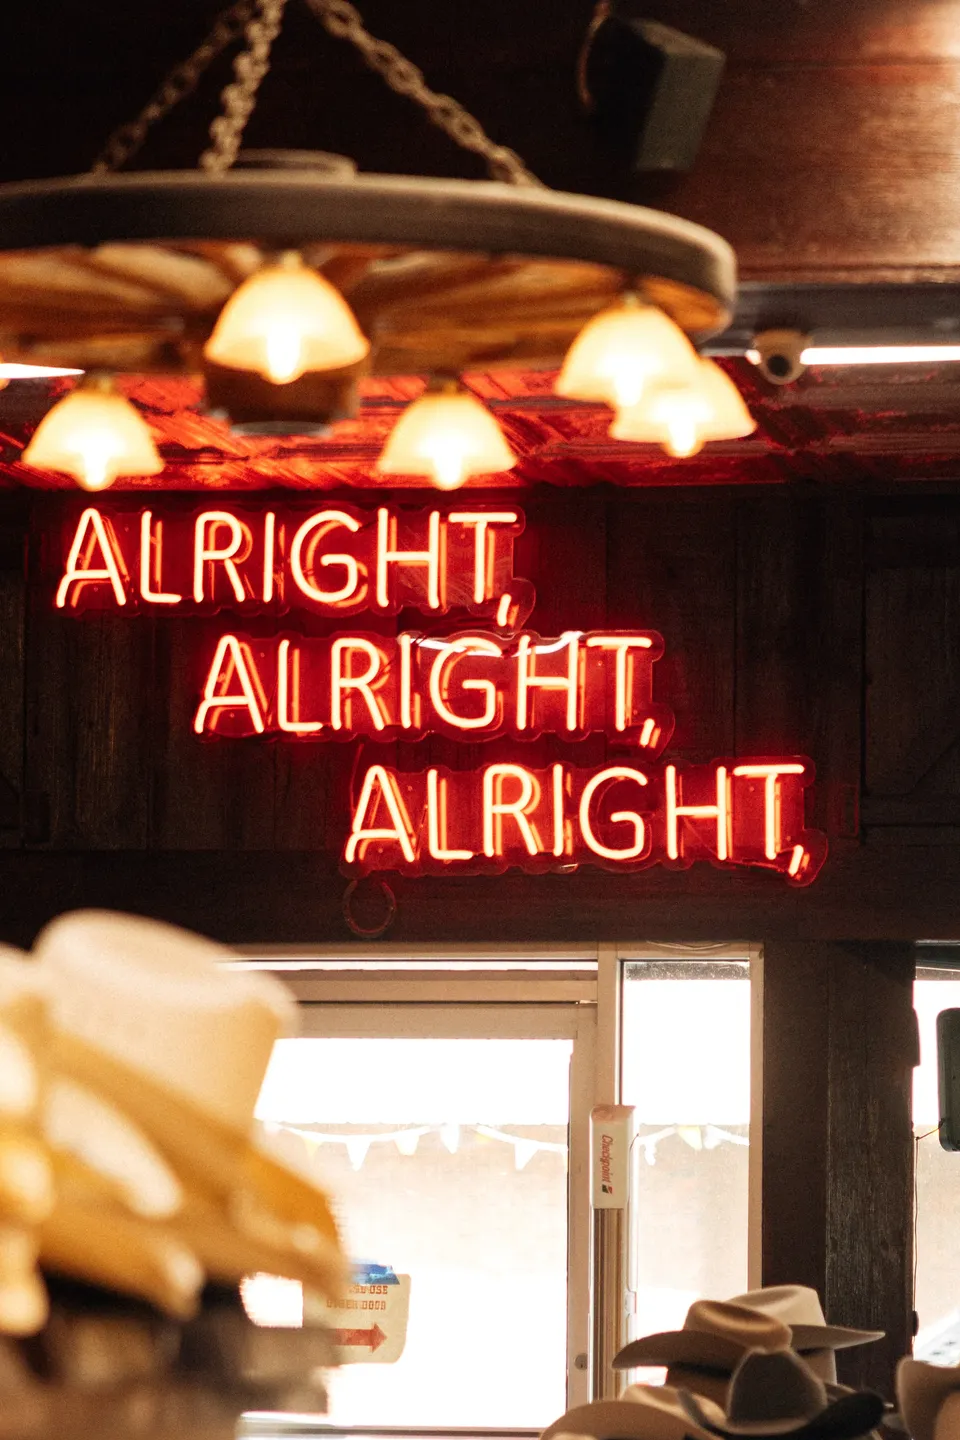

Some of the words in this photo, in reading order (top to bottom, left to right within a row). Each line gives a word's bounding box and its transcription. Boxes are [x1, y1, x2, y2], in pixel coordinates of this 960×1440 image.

[54, 508, 518, 627] ALRIGHT,
[193, 634, 659, 749] ALRIGHT,
[344, 763, 807, 876] ALRIGHT,
[600, 1134, 613, 1183] Checkpoint
[369, 1285, 388, 1295] USE
